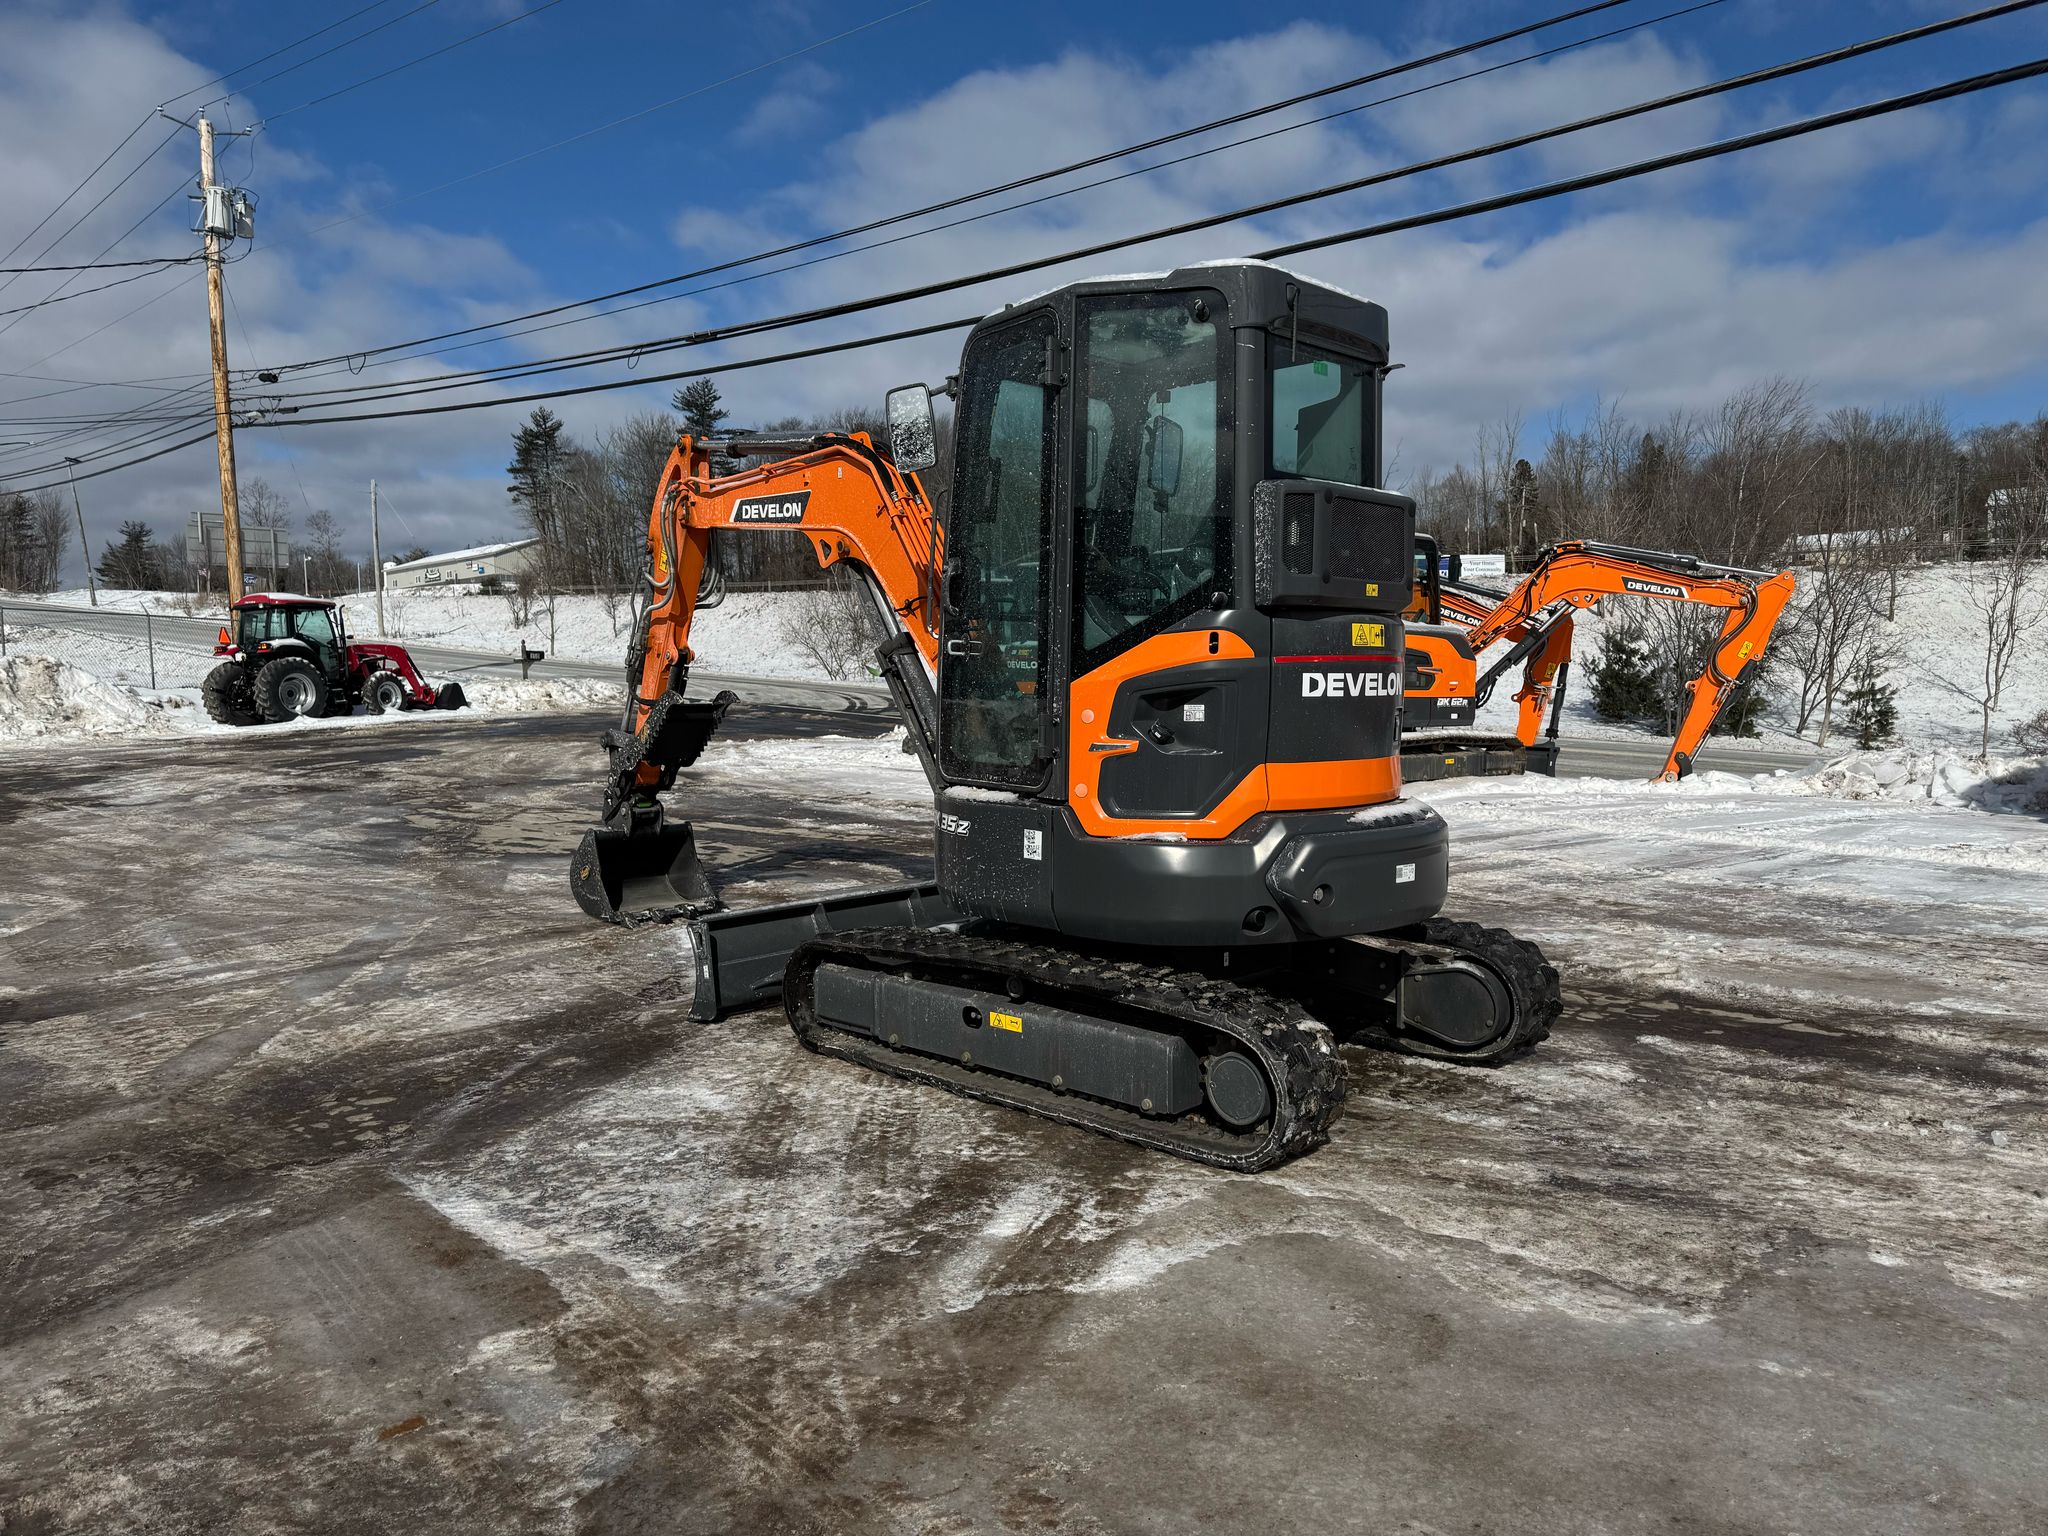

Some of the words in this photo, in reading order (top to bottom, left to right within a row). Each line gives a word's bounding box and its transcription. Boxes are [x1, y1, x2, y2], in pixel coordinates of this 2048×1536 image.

[742, 502, 801, 519] DEVELON
[1627, 581, 1679, 596] DEVELON
[1301, 672, 1403, 697] DEVELON
